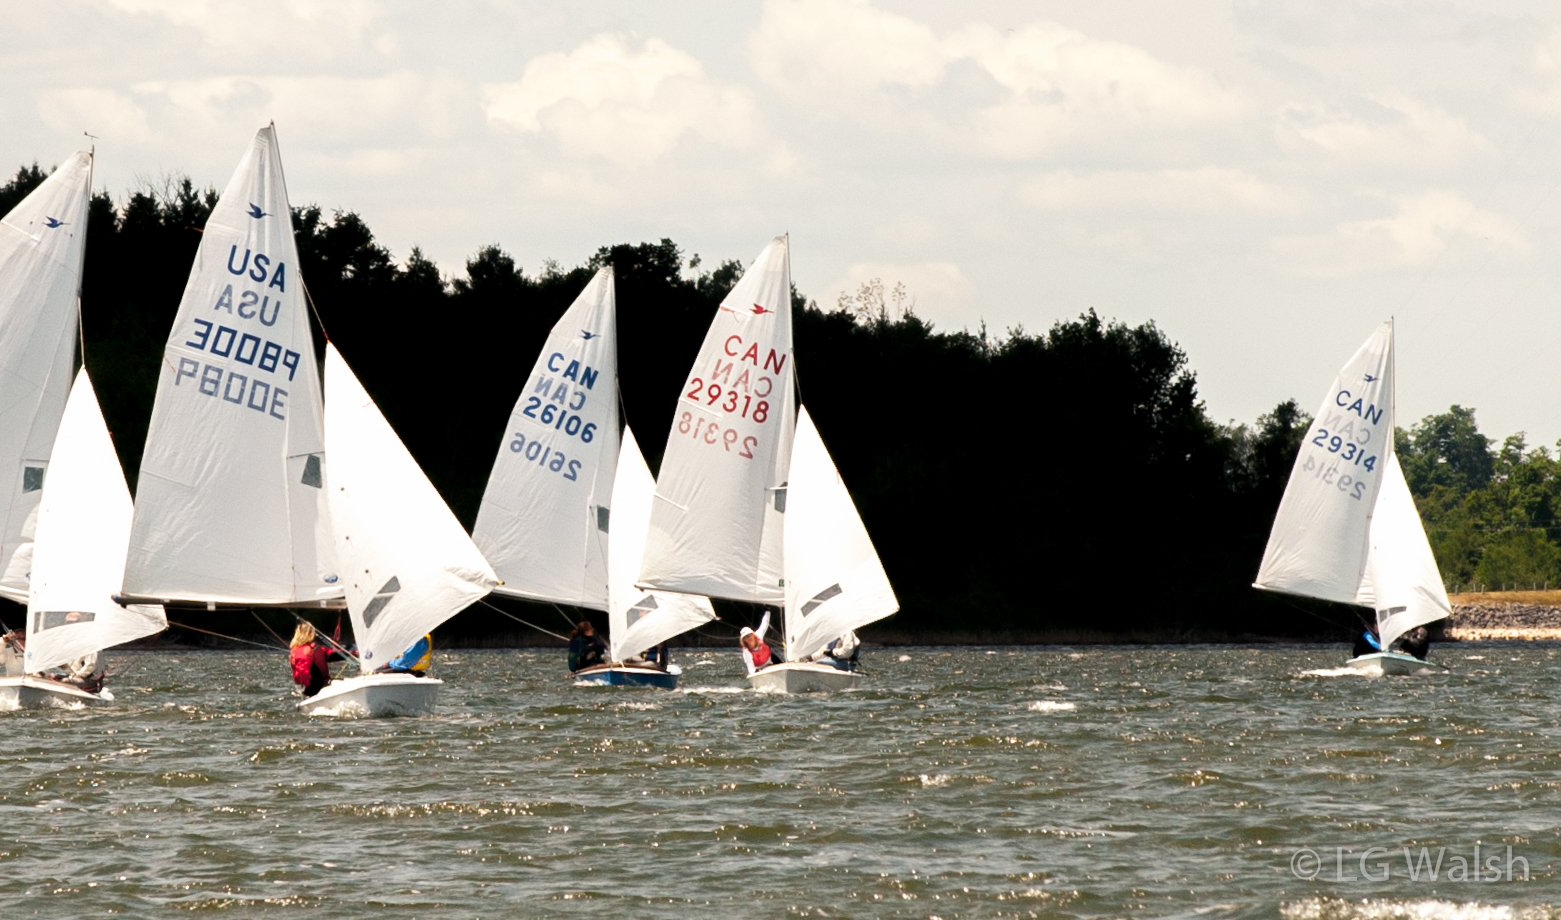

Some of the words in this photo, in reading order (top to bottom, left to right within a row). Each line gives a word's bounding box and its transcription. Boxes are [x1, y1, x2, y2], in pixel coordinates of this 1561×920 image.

[227, 244, 285, 293] USA
[185, 318, 301, 382] 30089
[547, 352, 599, 390] CAN
[724, 334, 787, 376] CAN
[522, 396, 598, 444] 26106
[687, 377, 769, 424] 29318
[1336, 390, 1384, 426] CAN
[1312, 428, 1377, 473] 29314
